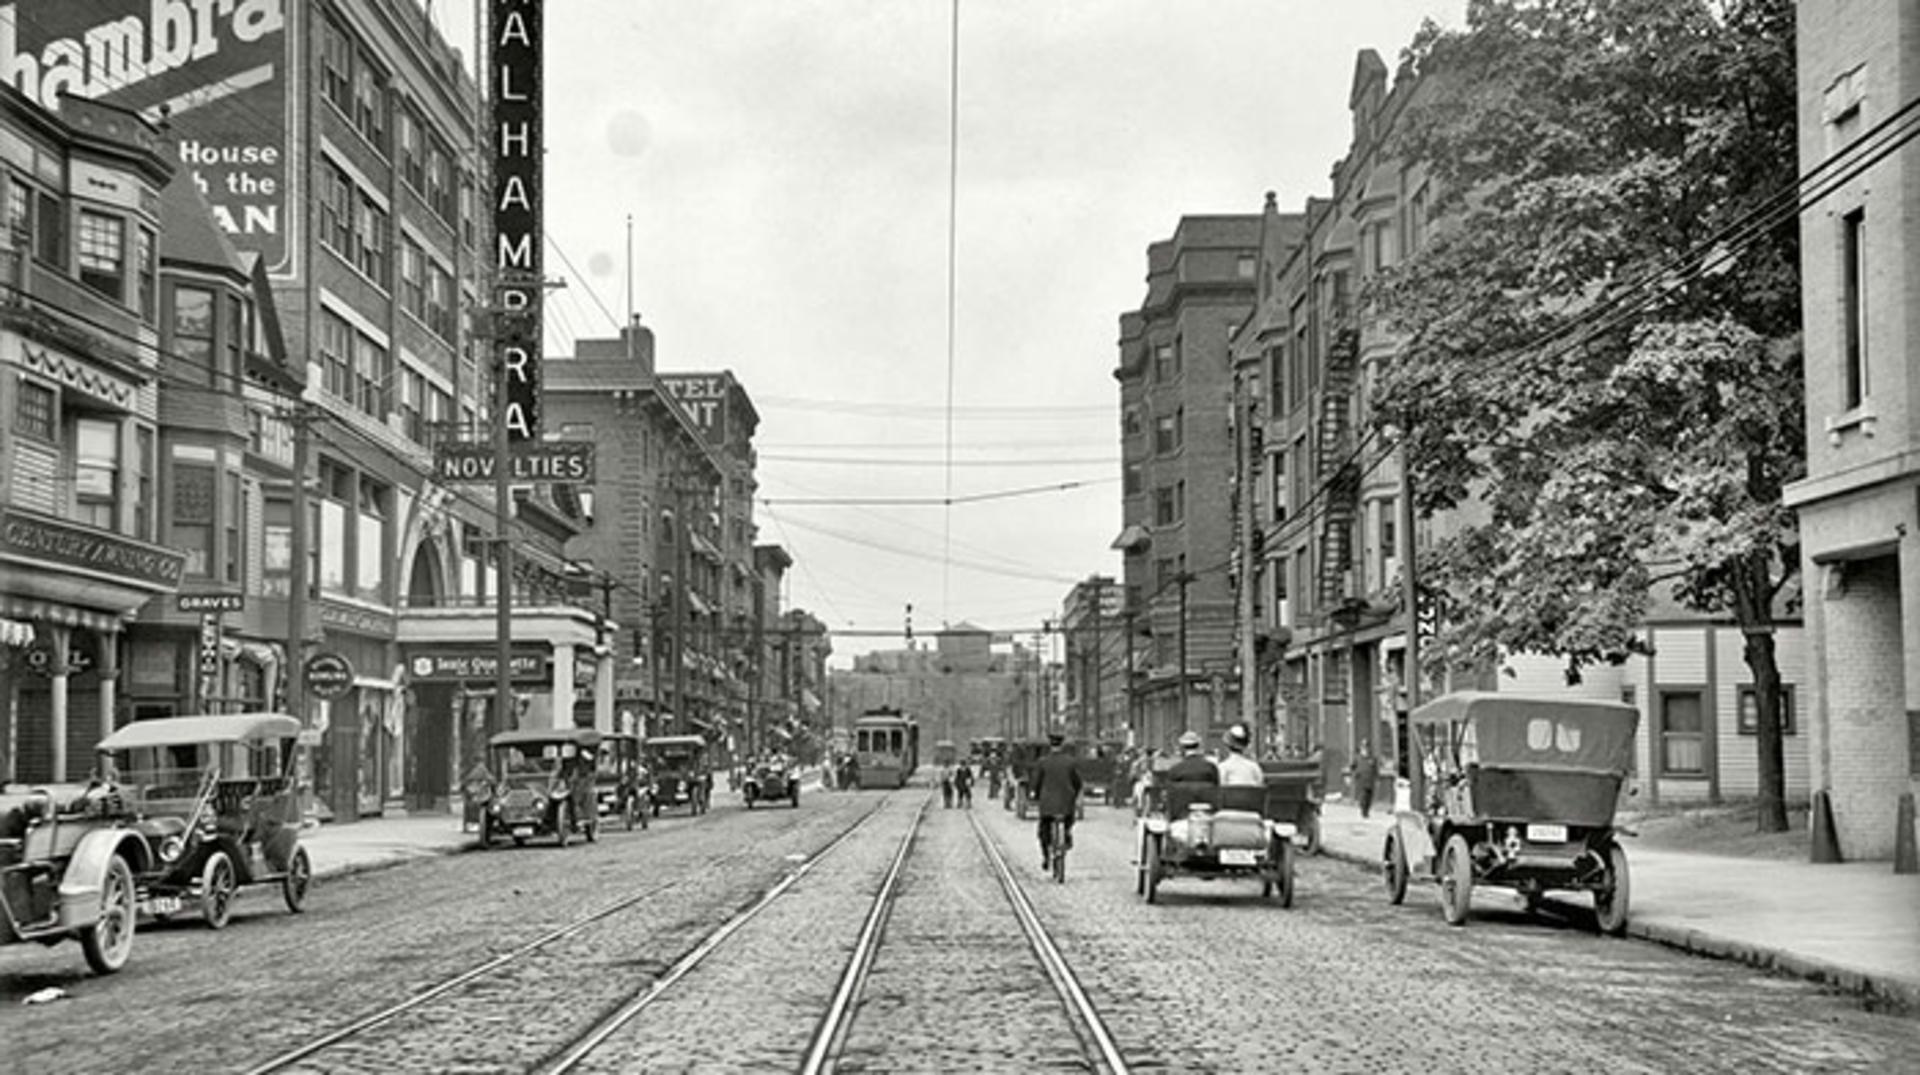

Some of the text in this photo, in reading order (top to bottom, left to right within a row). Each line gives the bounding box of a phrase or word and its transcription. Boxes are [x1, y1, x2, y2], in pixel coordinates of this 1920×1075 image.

[180, 141, 278, 165] House
[226, 171, 276, 194] the
[445, 455, 584, 477] NOVLTIES
[180, 597, 240, 609] GRAVES
